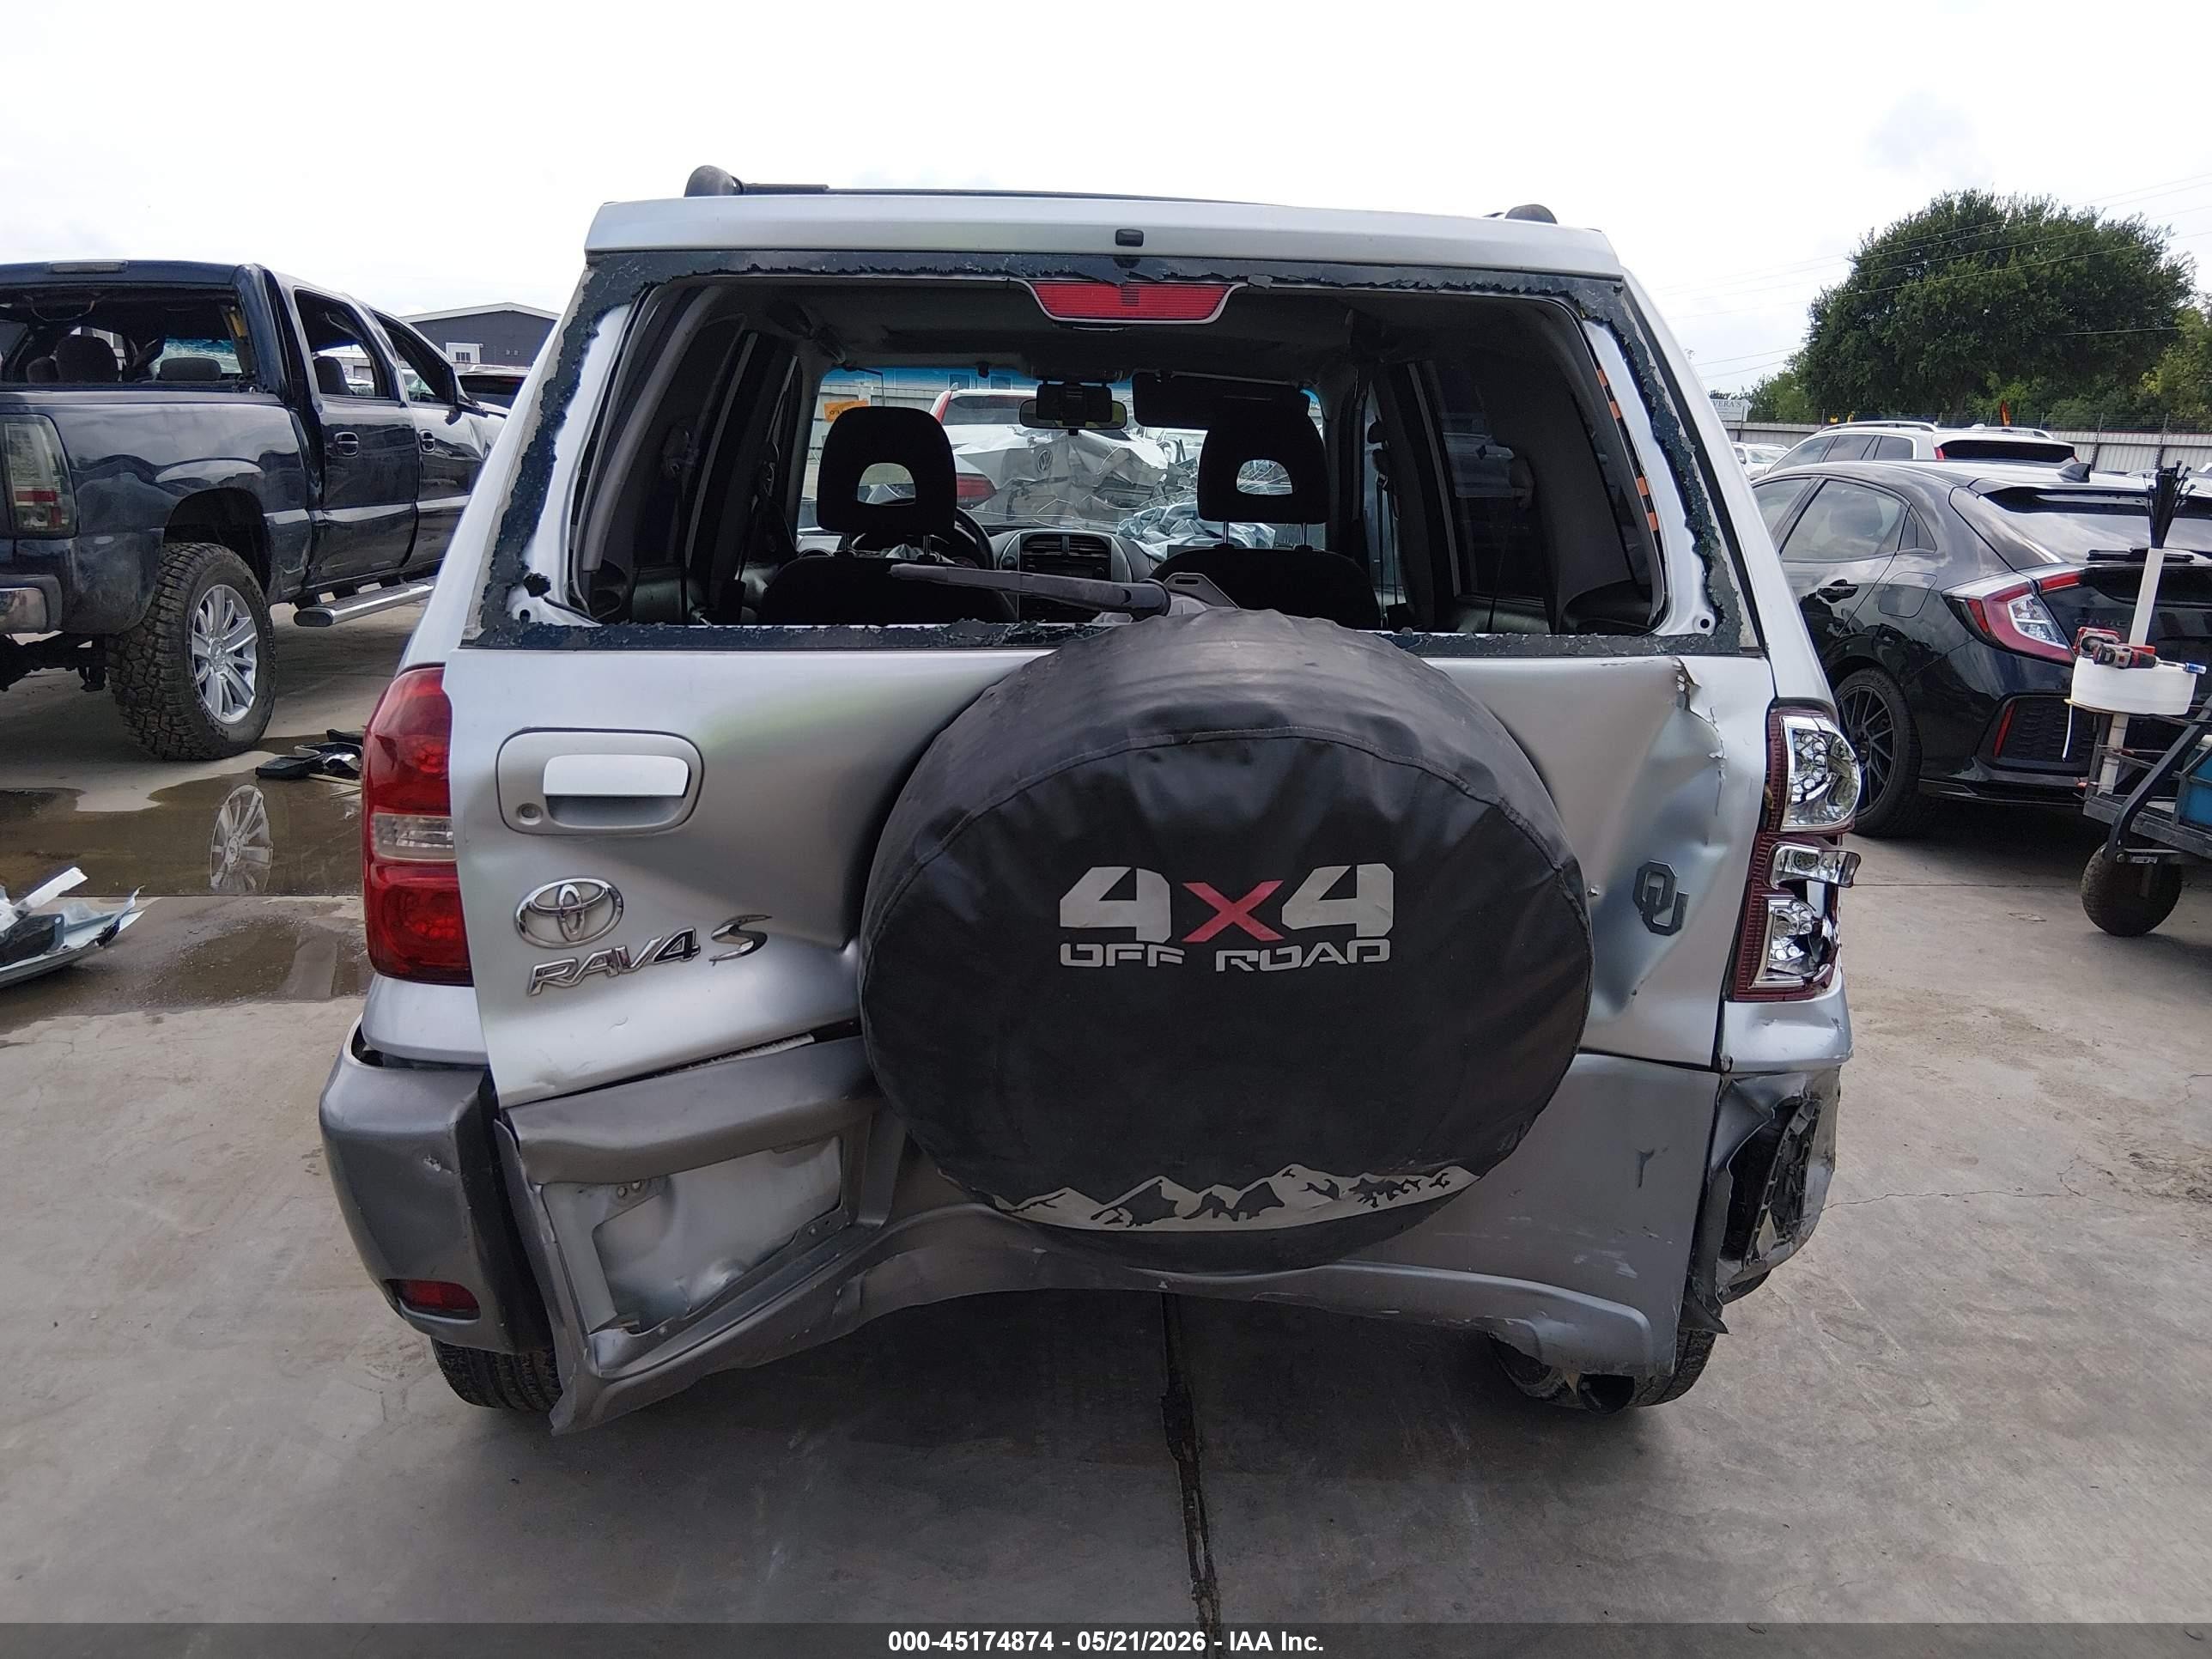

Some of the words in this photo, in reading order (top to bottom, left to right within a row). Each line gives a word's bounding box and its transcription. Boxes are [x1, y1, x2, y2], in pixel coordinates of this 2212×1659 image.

[528, 927, 701, 997] RAV4
[1060, 943, 1185, 968] OFF
[1215, 939, 1391, 972] ROAD
